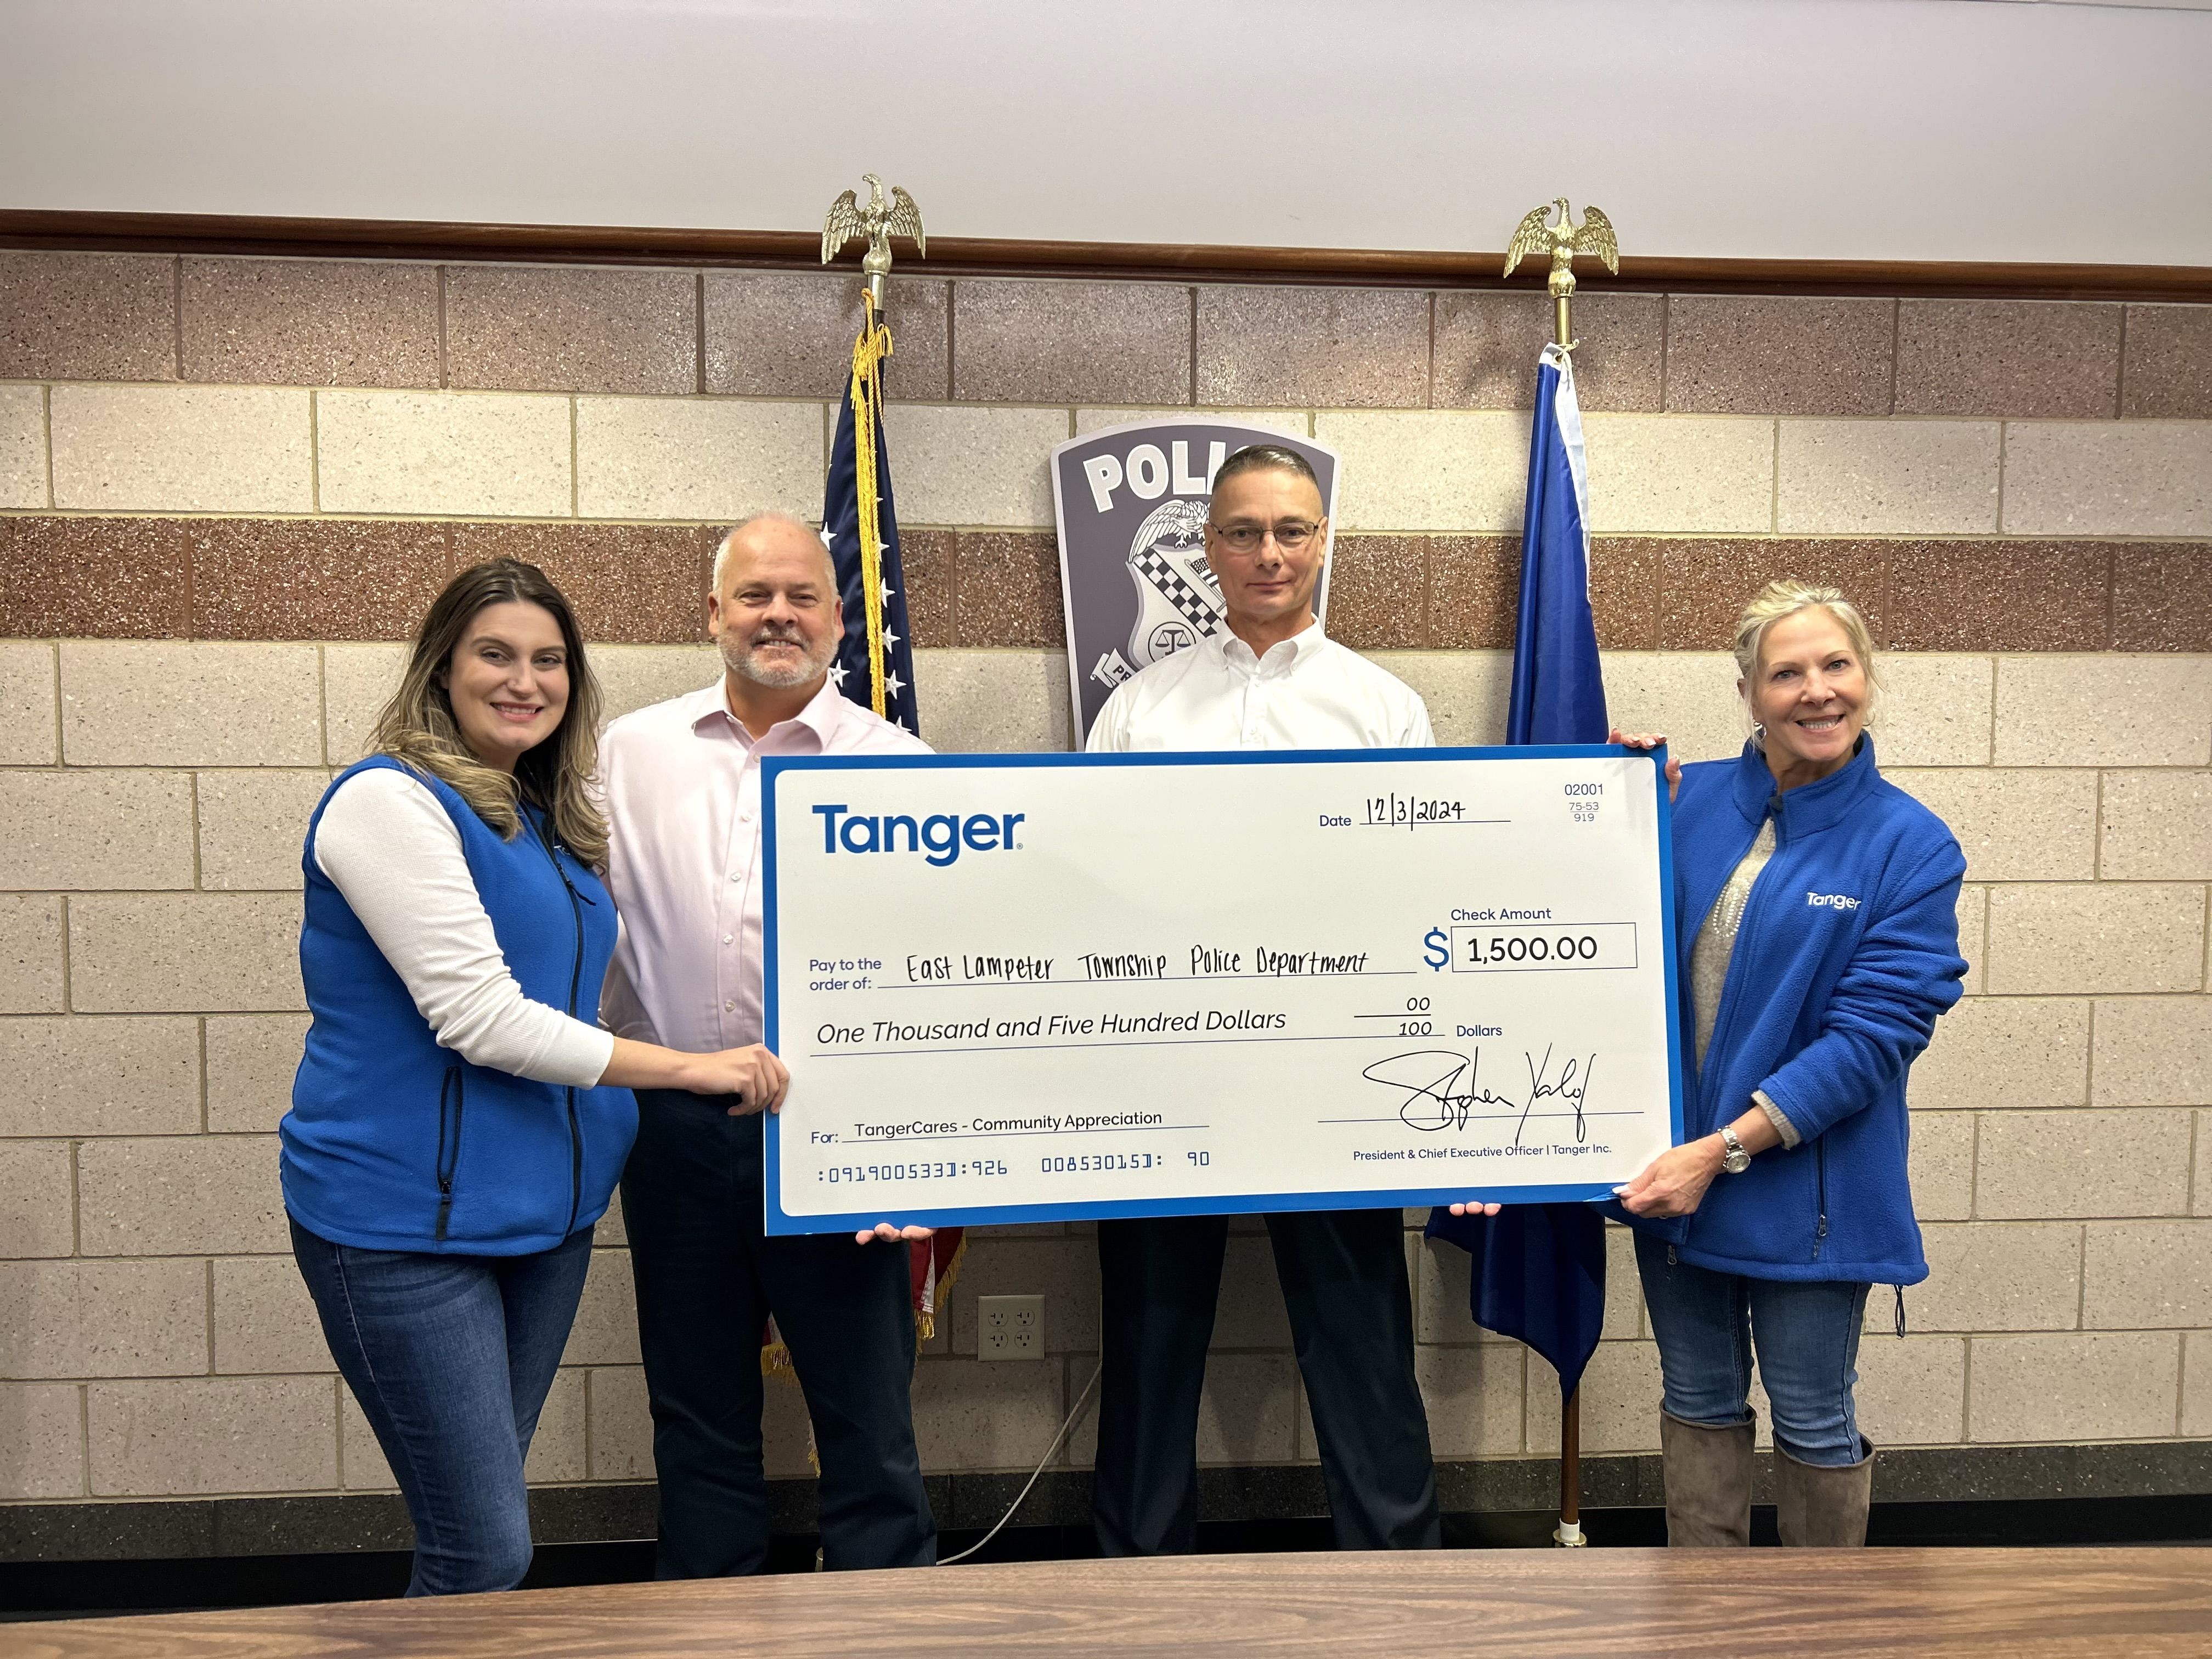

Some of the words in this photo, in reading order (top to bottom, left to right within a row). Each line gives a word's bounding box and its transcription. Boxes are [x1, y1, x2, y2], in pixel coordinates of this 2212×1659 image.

[1565, 783, 1603, 795] 02001
[1366, 792, 1466, 831] 12/3/2024
[1568, 802, 1599, 811] 75-53
[1319, 815, 1352, 827] Date
[1574, 813, 1594, 822] 919
[1807, 892, 1861, 910] Tanger
[1451, 908, 1497, 921] Check
[1499, 907, 1552, 920] Amount
[1423, 926, 1449, 972] $
[1468, 935, 1598, 966] 1,500.00
[809, 959, 836, 973] Pay
[839, 959, 855, 970] to
[857, 957, 883, 970] the
[907, 955, 953, 983] East
[963, 955, 1054, 982] Lampeter
[1077, 952, 1167, 979] Township
[1191, 944, 1241, 975] Police
[1256, 946, 1370, 976] Department
[809, 978, 850, 991] order
[852, 976, 872, 990] of:
[1406, 997, 1430, 1011] 00
[817, 1024, 865, 1044] One
[872, 1017, 991, 1042] Thousand
[996, 1015, 1042, 1037] and
[1048, 1014, 1094, 1036] Five
[1100, 1011, 1200, 1034] Hundred
[1205, 1009, 1286, 1030] Dollars
[1398, 1021, 1432, 1036] 100
[1456, 1024, 1503, 1037] Dollars
[854, 1121, 958, 1138] TangerCares
[972, 1115, 1062, 1132] Community
[1064, 1110, 1163, 1129] Appreciation
[811, 1131, 839, 1144] For:
[1187, 1151, 1209, 1166] 90
[1353, 1149, 1406, 1161] President
[1408, 1149, 1416, 1159] &
[1418, 1148, 1448, 1159] Chief
[1450, 1146, 1503, 1158] Executive
[1505, 1144, 1544, 1156] Officer
[1551, 1143, 1591, 1156] Tanger
[1593, 1143, 1612, 1153] Inc.
